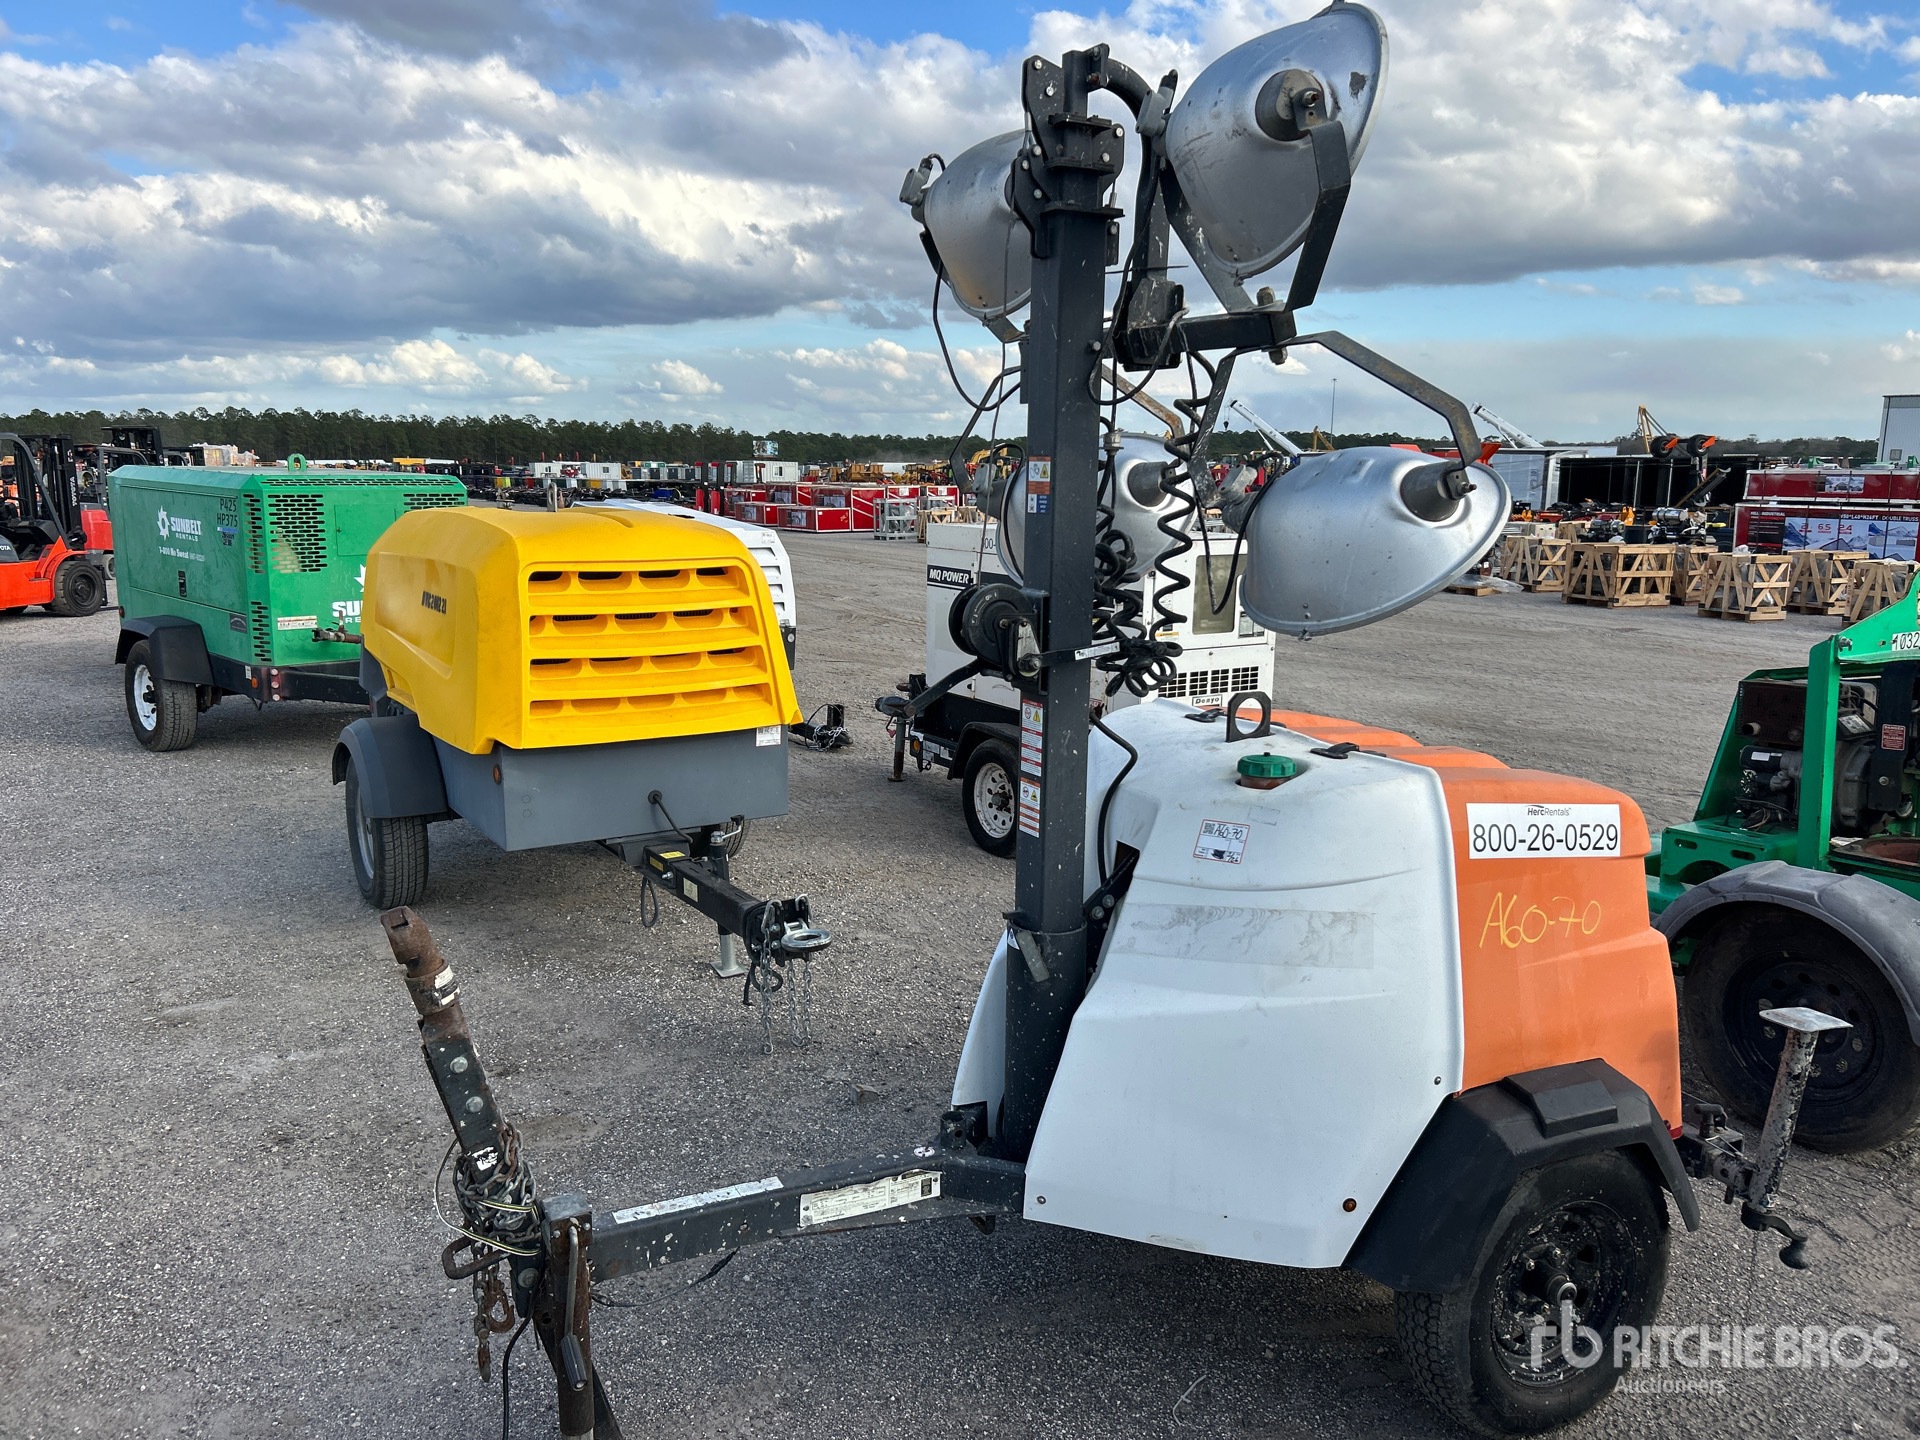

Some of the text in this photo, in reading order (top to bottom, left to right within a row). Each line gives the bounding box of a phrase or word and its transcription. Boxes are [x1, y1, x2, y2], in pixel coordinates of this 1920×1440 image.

[70, 476, 78, 507] TOYOTA
[220, 498, 237, 512] P425
[170, 516, 202, 536] SUNBELT
[216, 513, 238, 527] HP375
[929, 568, 970, 584] MQ POWER
[332, 600, 364, 618] SU
[1195, 697, 1220, 705] Denyo
[1472, 823, 1619, 852] 800-26-0529
[1479, 891, 1602, 949] A60-70
